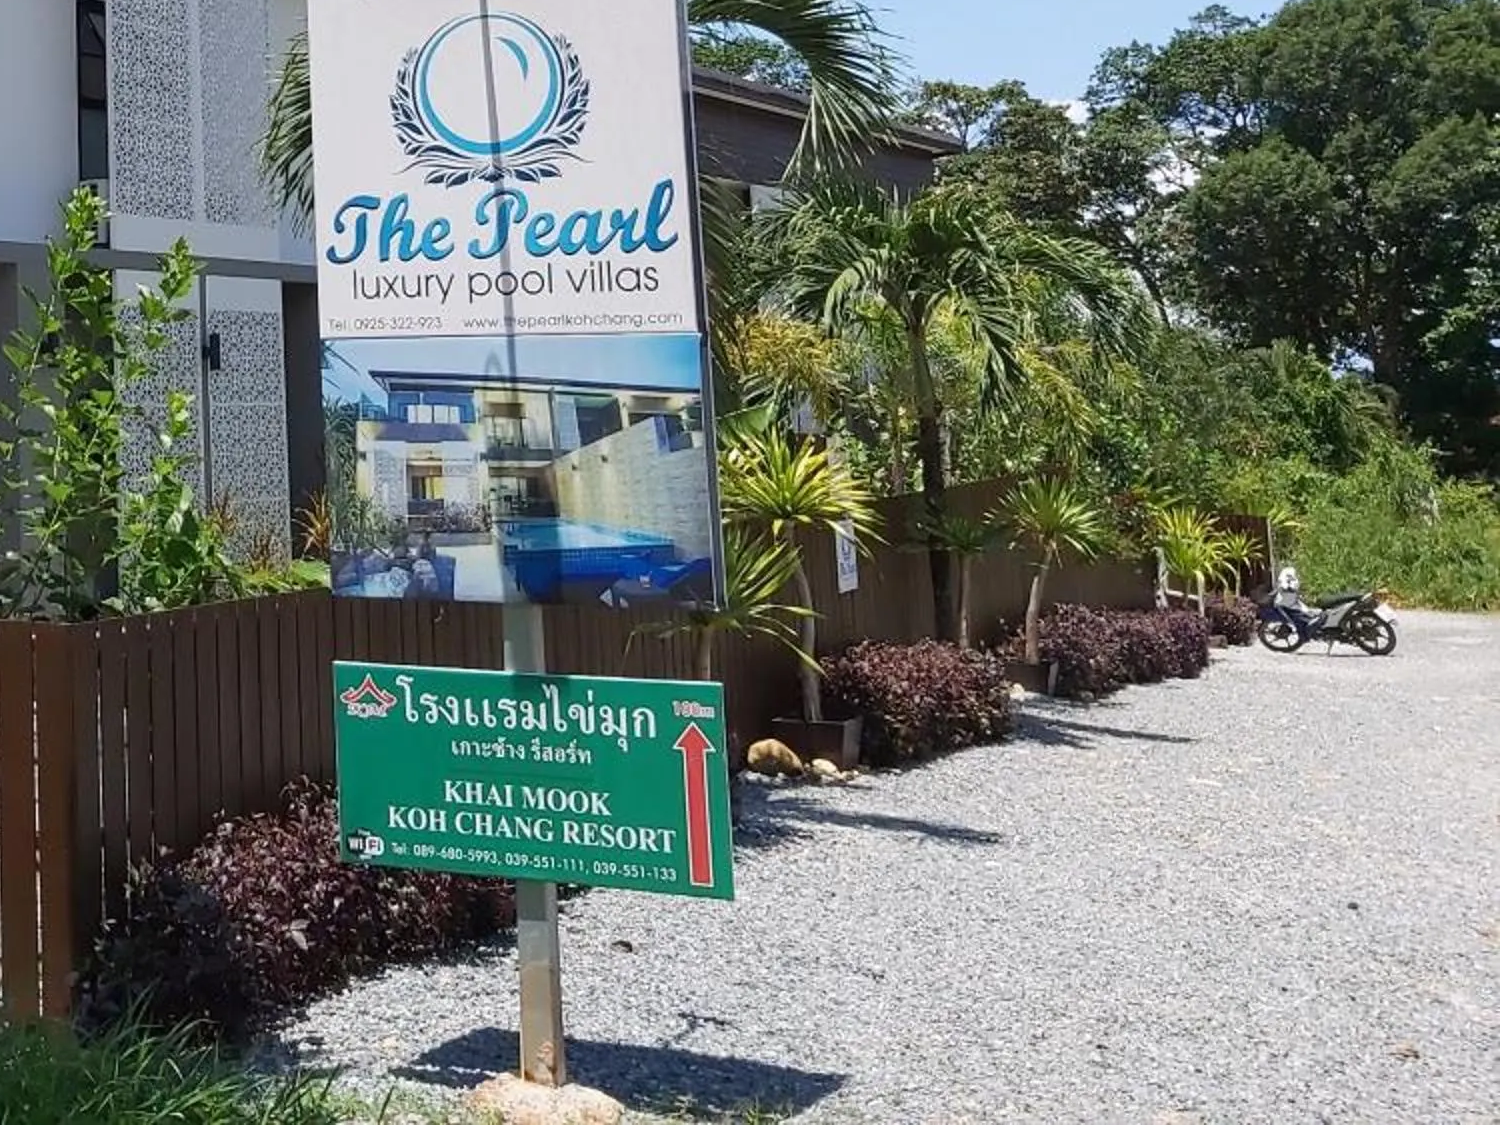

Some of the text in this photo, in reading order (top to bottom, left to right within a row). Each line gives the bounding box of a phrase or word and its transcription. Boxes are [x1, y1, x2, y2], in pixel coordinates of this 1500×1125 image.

[326, 178, 680, 265] The Pearl
[352, 260, 660, 305] luxury pool villas
[395, 674, 657, 752] โรงแรมไข่มุก
[451, 736, 592, 764] เกาะช้าง รีสอร์ท
[443, 779, 612, 816] KHAI MOOK
[388, 805, 677, 853] KOH CHANG RESORT
[593, 861, 677, 882] 039-551-133
